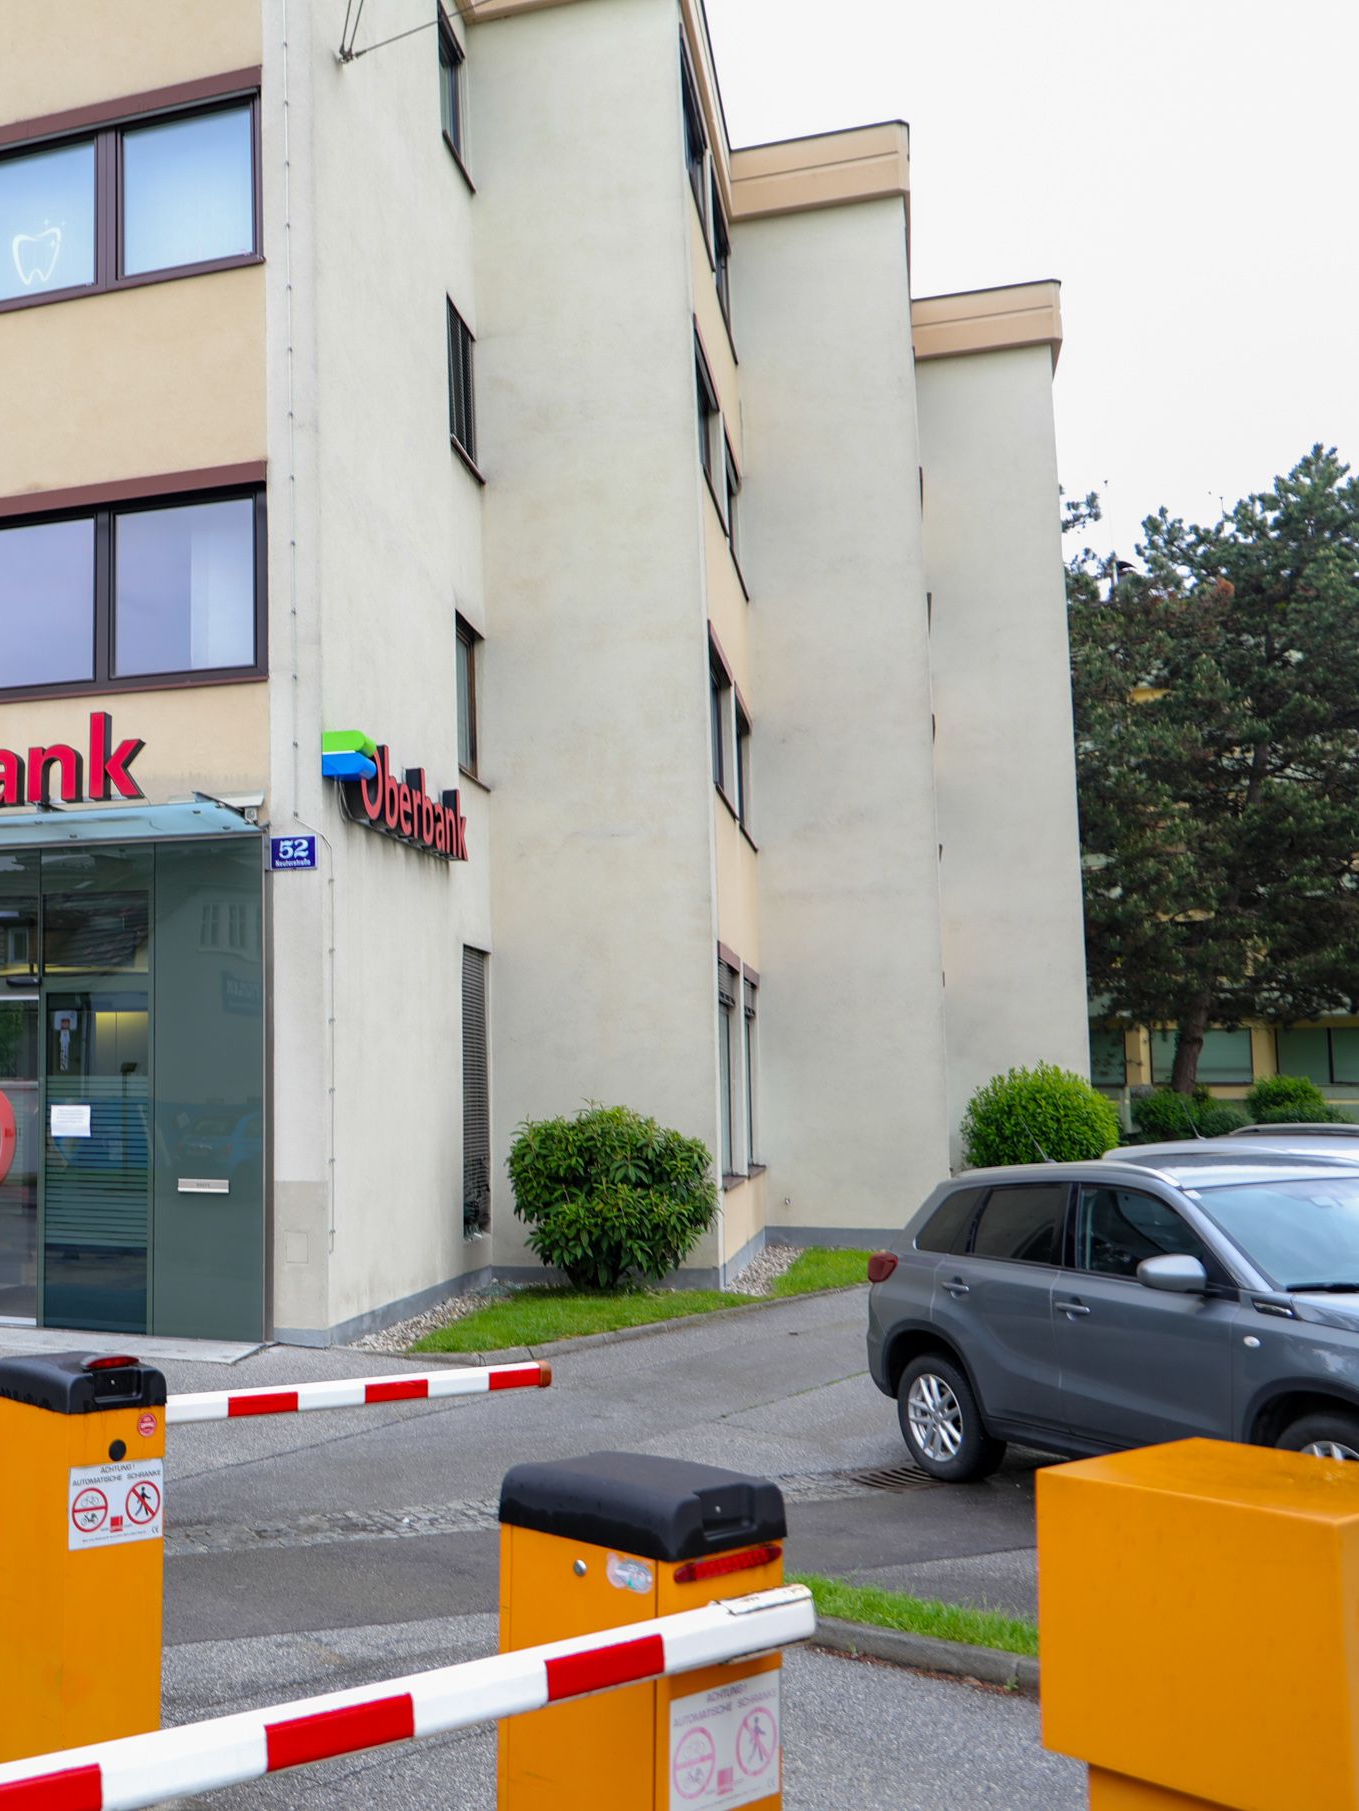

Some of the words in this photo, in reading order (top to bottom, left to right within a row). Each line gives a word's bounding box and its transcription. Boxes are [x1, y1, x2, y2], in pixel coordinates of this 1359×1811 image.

[361, 744, 468, 862] Oberbank
[279, 838, 309, 859] 52
[72, 1474, 122, 1487] AUTOMATISCHE
[127, 1470, 161, 1480] SCHRANKE
